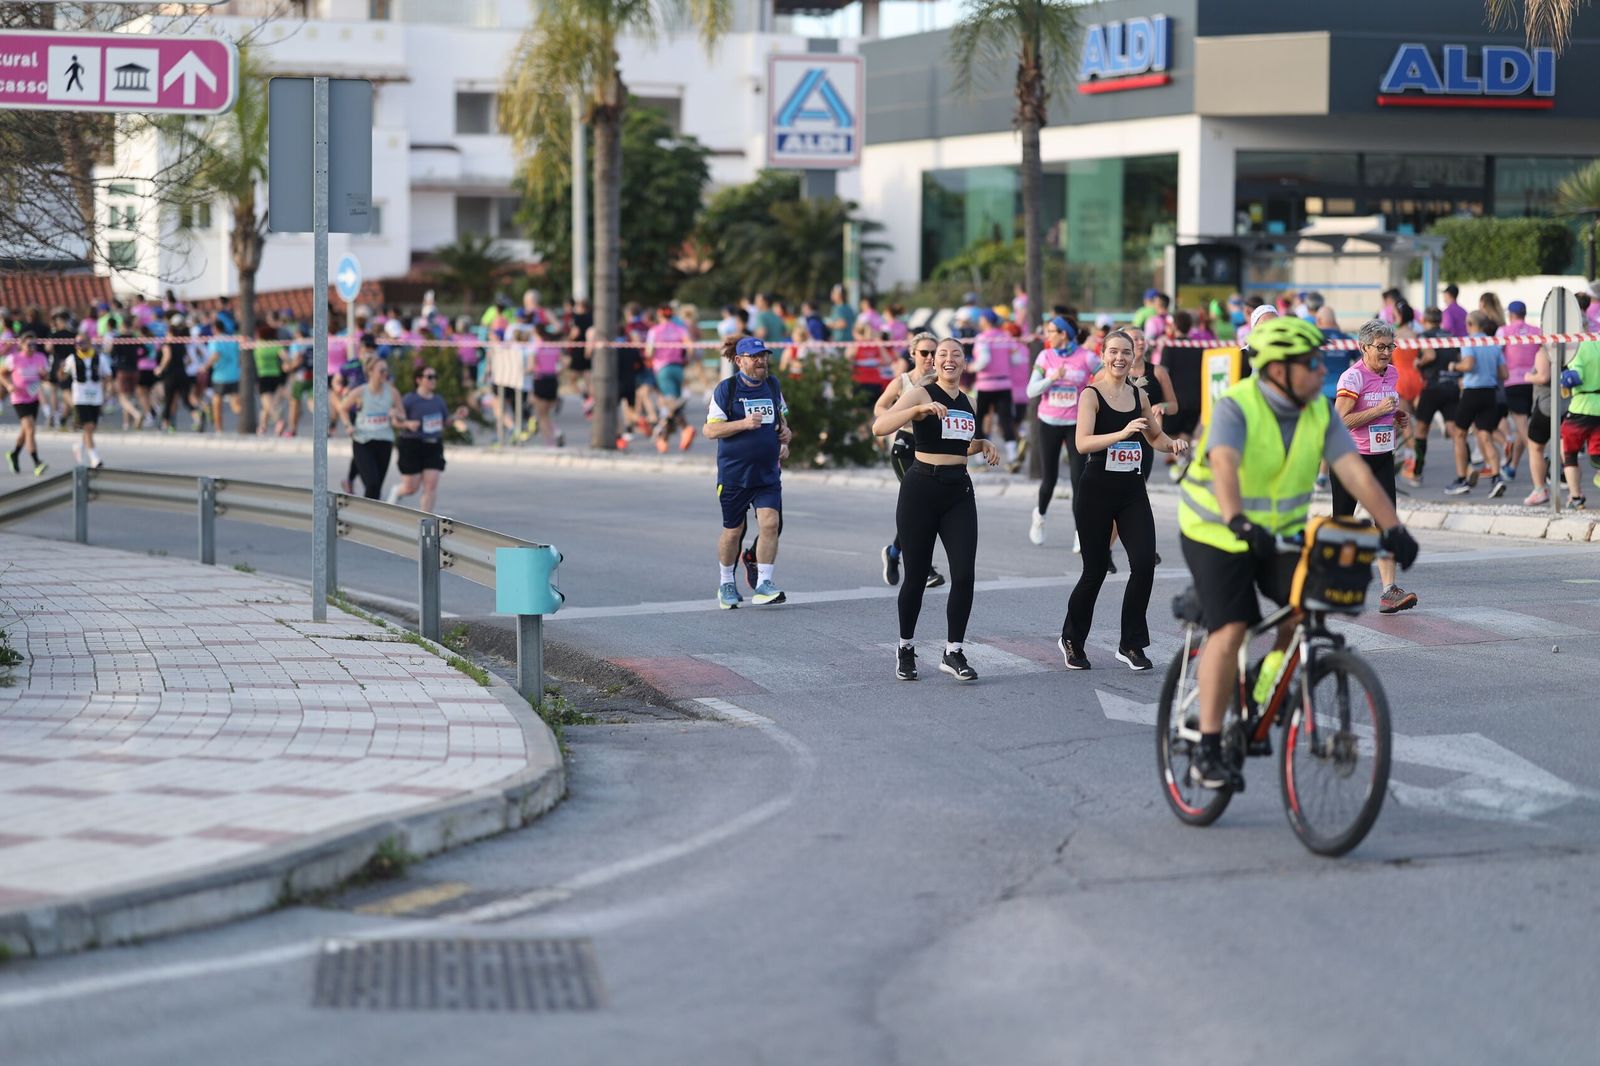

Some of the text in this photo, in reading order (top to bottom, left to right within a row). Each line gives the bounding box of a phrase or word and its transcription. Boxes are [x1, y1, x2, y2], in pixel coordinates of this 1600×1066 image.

[1078, 13, 1170, 81] ALDI
[1379, 43, 1556, 97] ALDI
[780, 133, 848, 153] ALDI
[945, 417, 974, 431] 1135
[1375, 432, 1391, 443] 682
[1110, 450, 1140, 461] 1643
